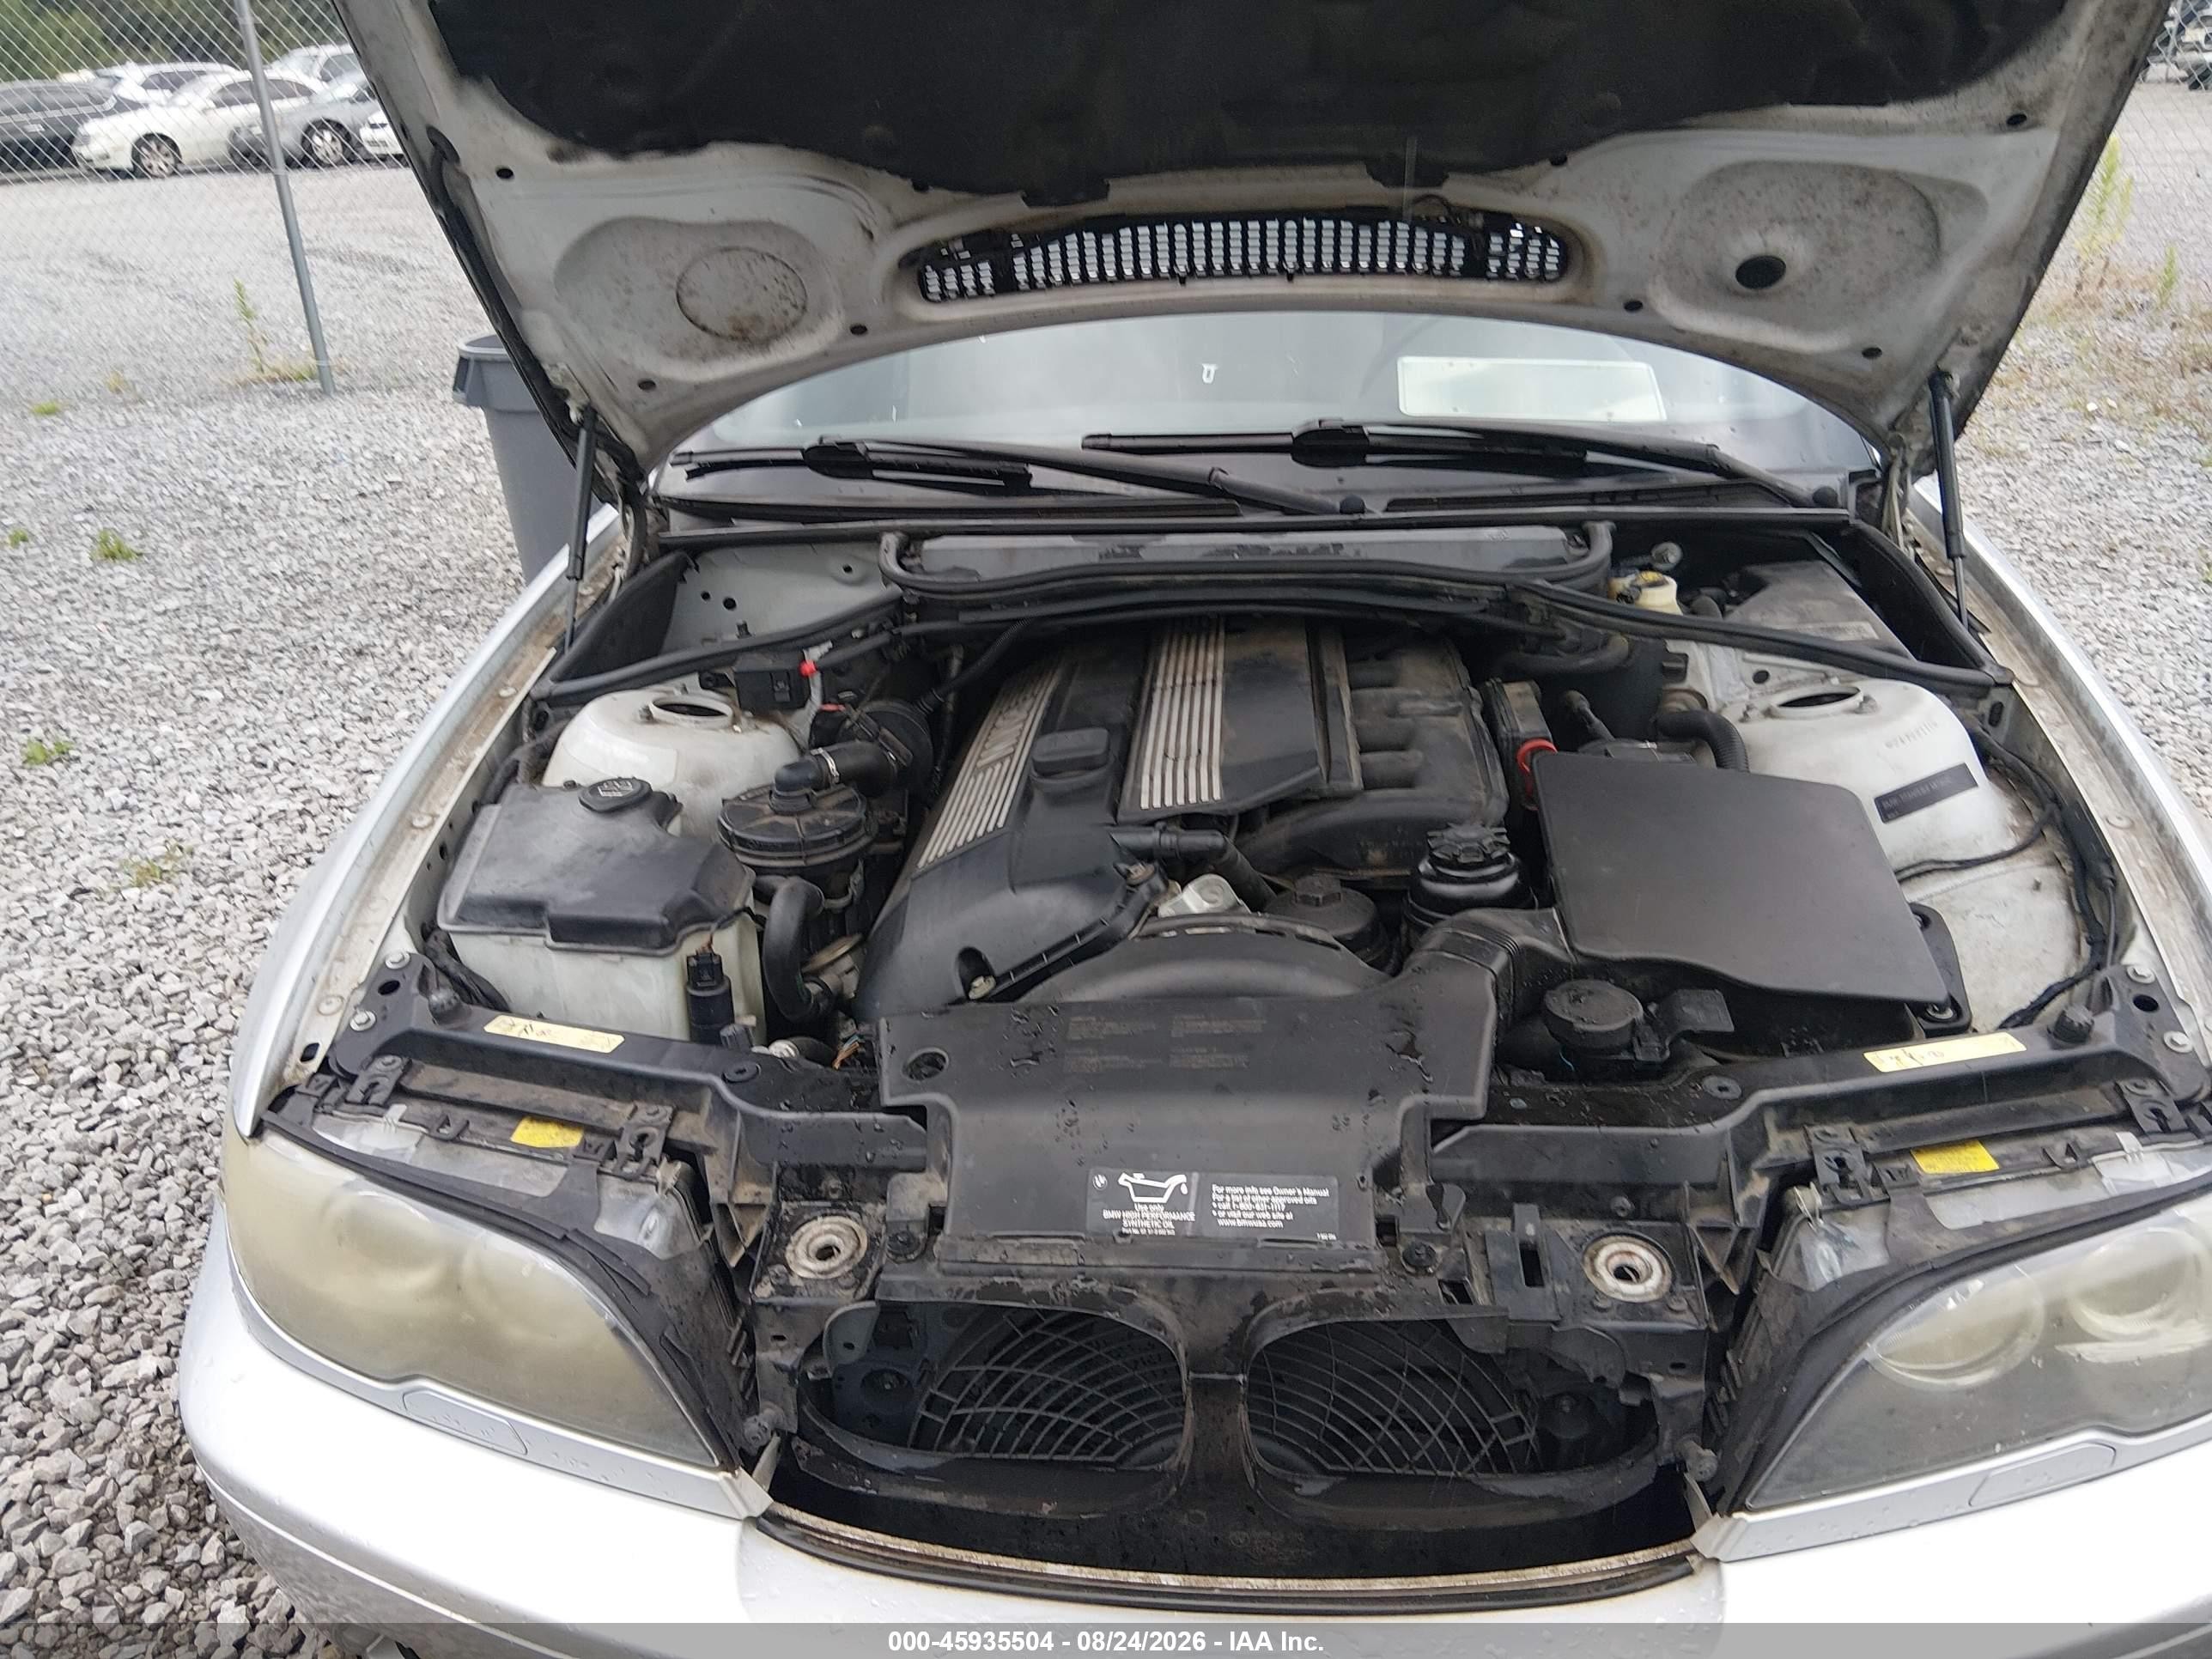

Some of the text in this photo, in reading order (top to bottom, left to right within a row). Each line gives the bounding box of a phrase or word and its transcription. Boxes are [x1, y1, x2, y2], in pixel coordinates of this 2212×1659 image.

[1212, 1184, 1224, 1194] For
[1224, 1186, 1244, 1194] more
[1212, 1193, 1224, 1202] For
[1103, 1209, 1121, 1219] BMW
[1140, 1210, 1195, 1222] PERFORMANCE
